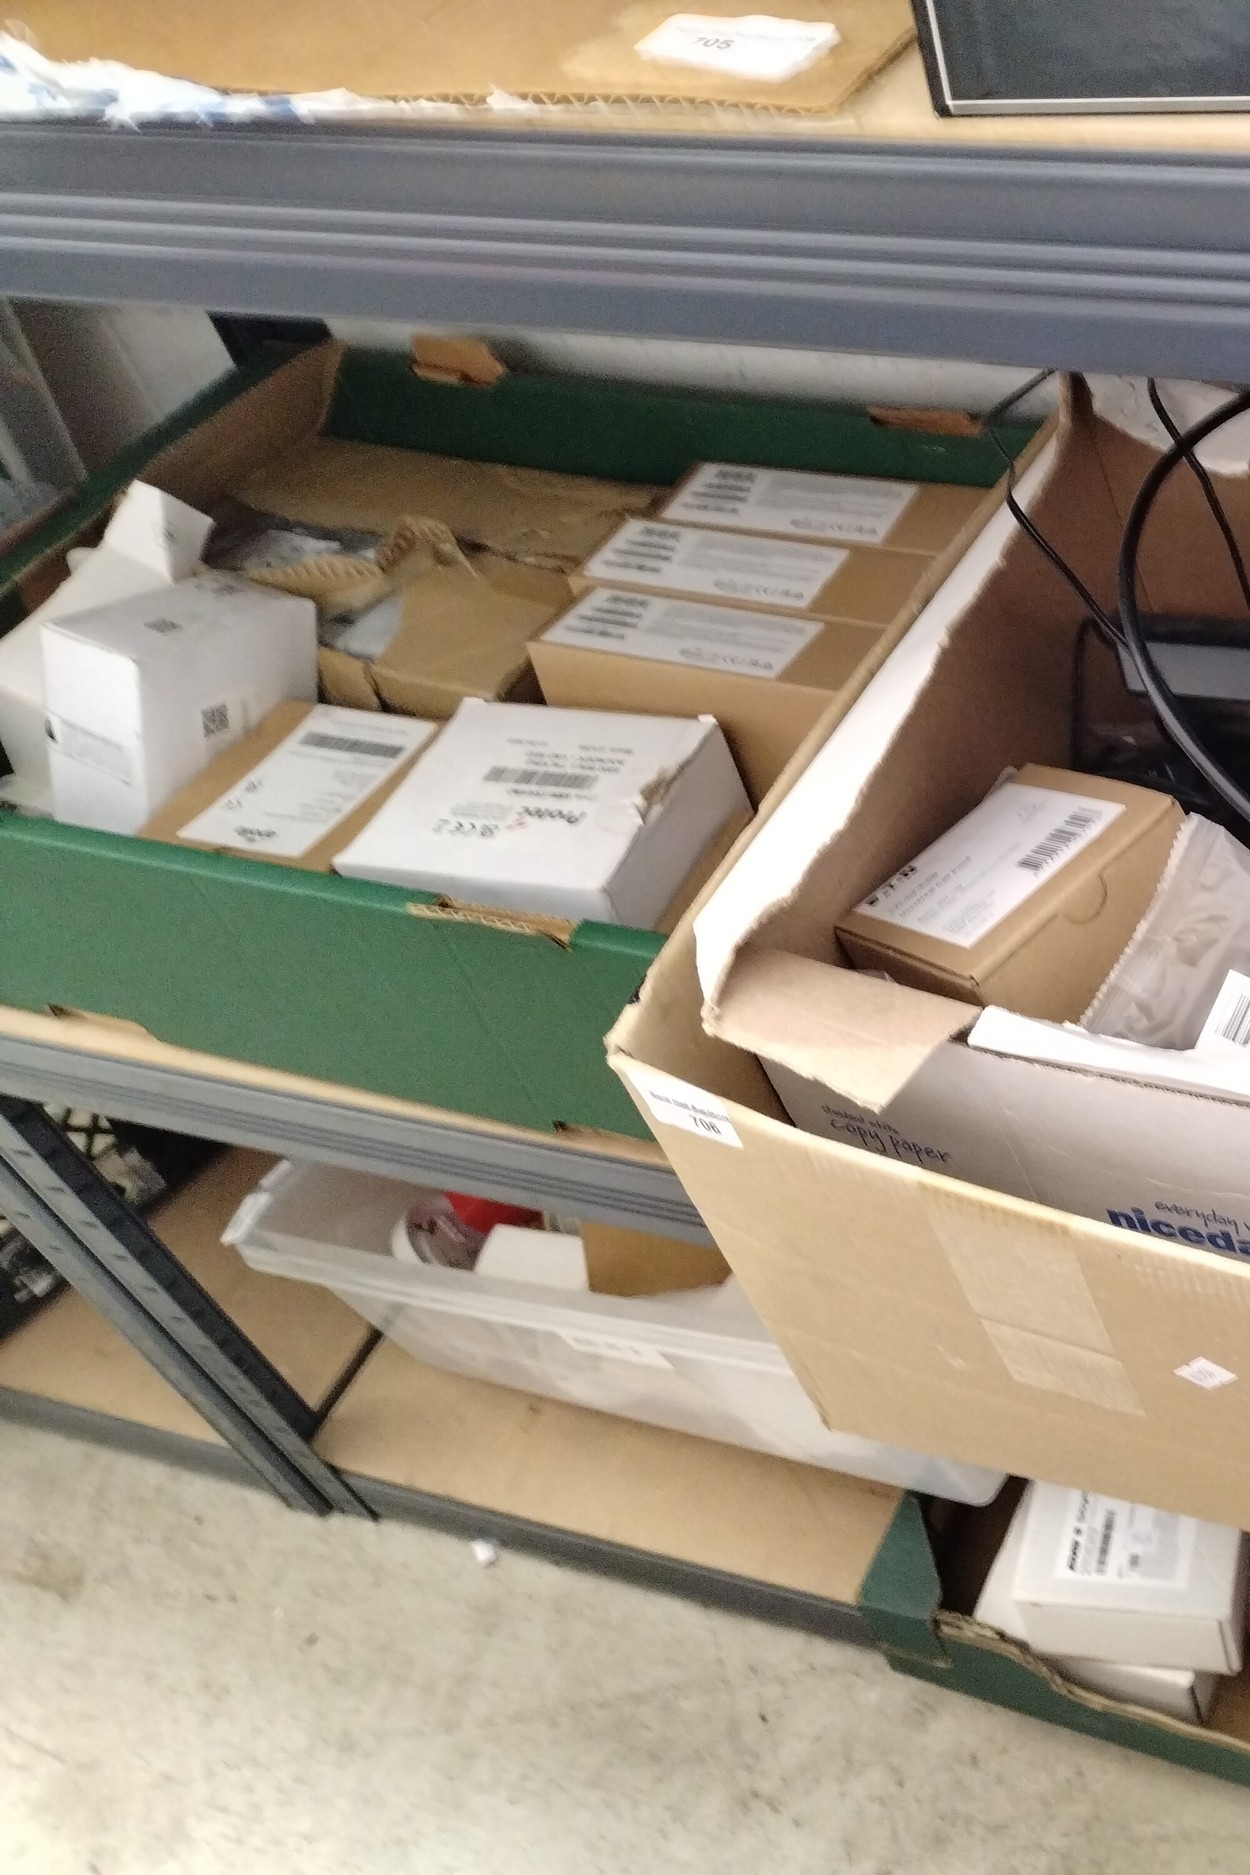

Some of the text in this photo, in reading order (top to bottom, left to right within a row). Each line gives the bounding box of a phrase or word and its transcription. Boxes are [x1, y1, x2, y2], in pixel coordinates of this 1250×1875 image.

[693, 36, 735, 50] 705
[888, 1134, 952, 1164] paper
[1155, 1200, 1239, 1235] everyday
